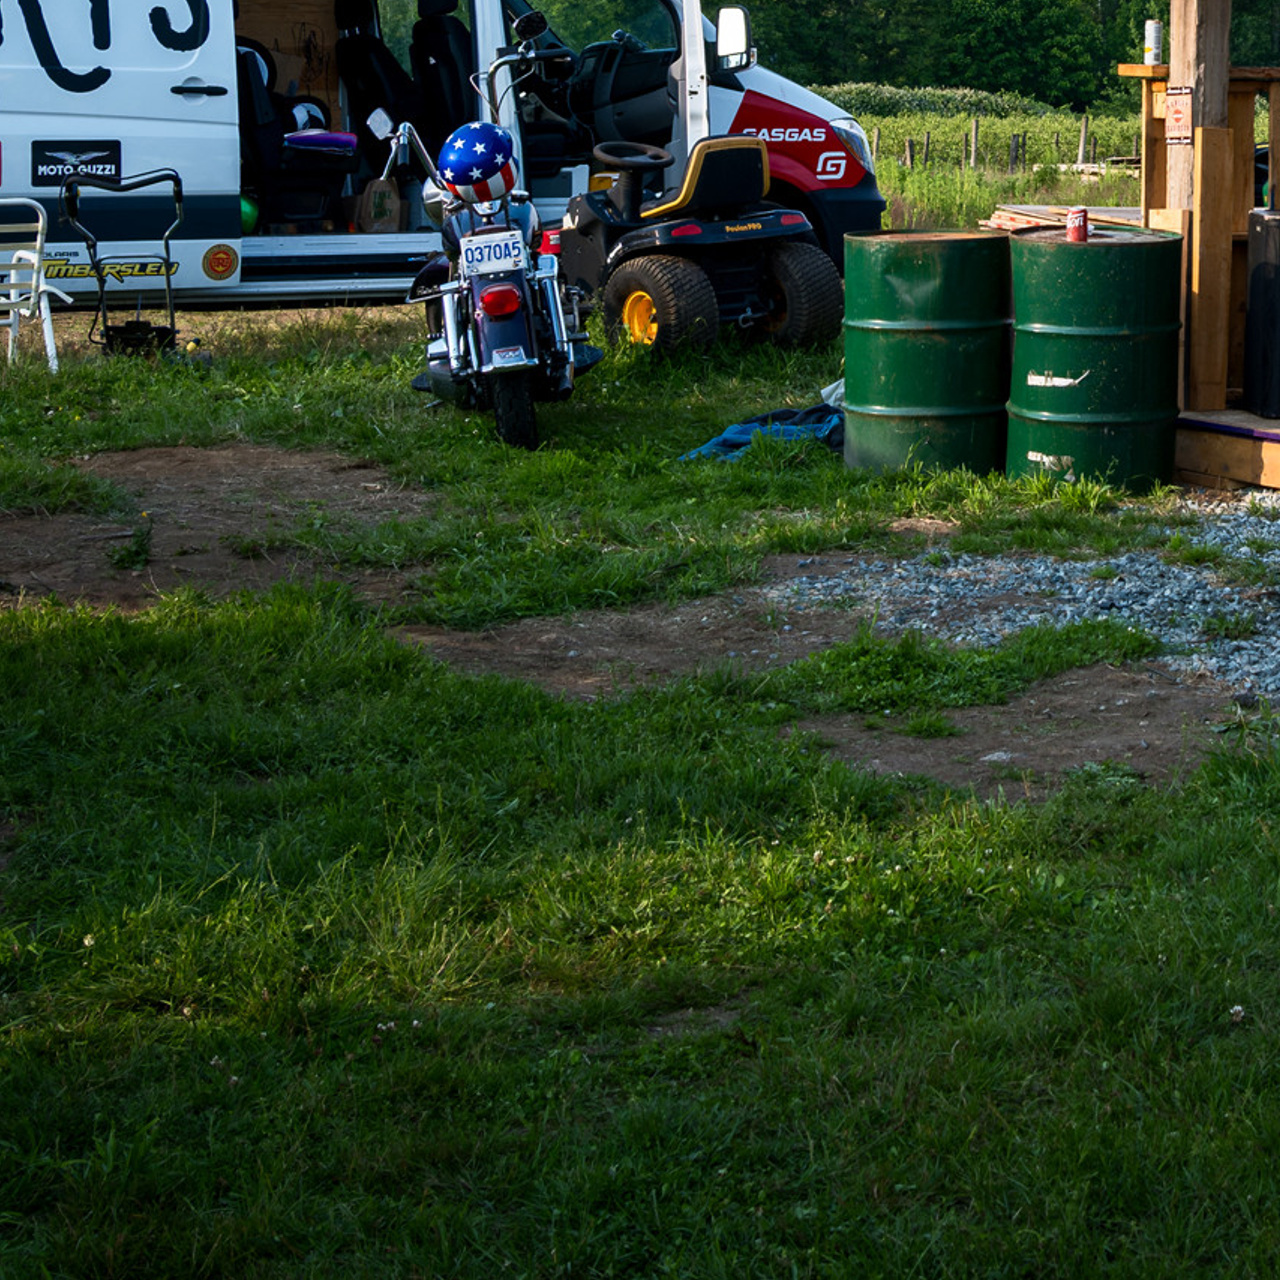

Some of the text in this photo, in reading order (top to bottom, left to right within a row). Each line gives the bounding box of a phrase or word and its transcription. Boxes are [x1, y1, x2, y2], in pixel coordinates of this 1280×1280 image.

[37, 164, 116, 176] MOTO GUZZI
[465, 240, 521, 264] 0370A5
[42, 258, 180, 283] TIMBRSLED
